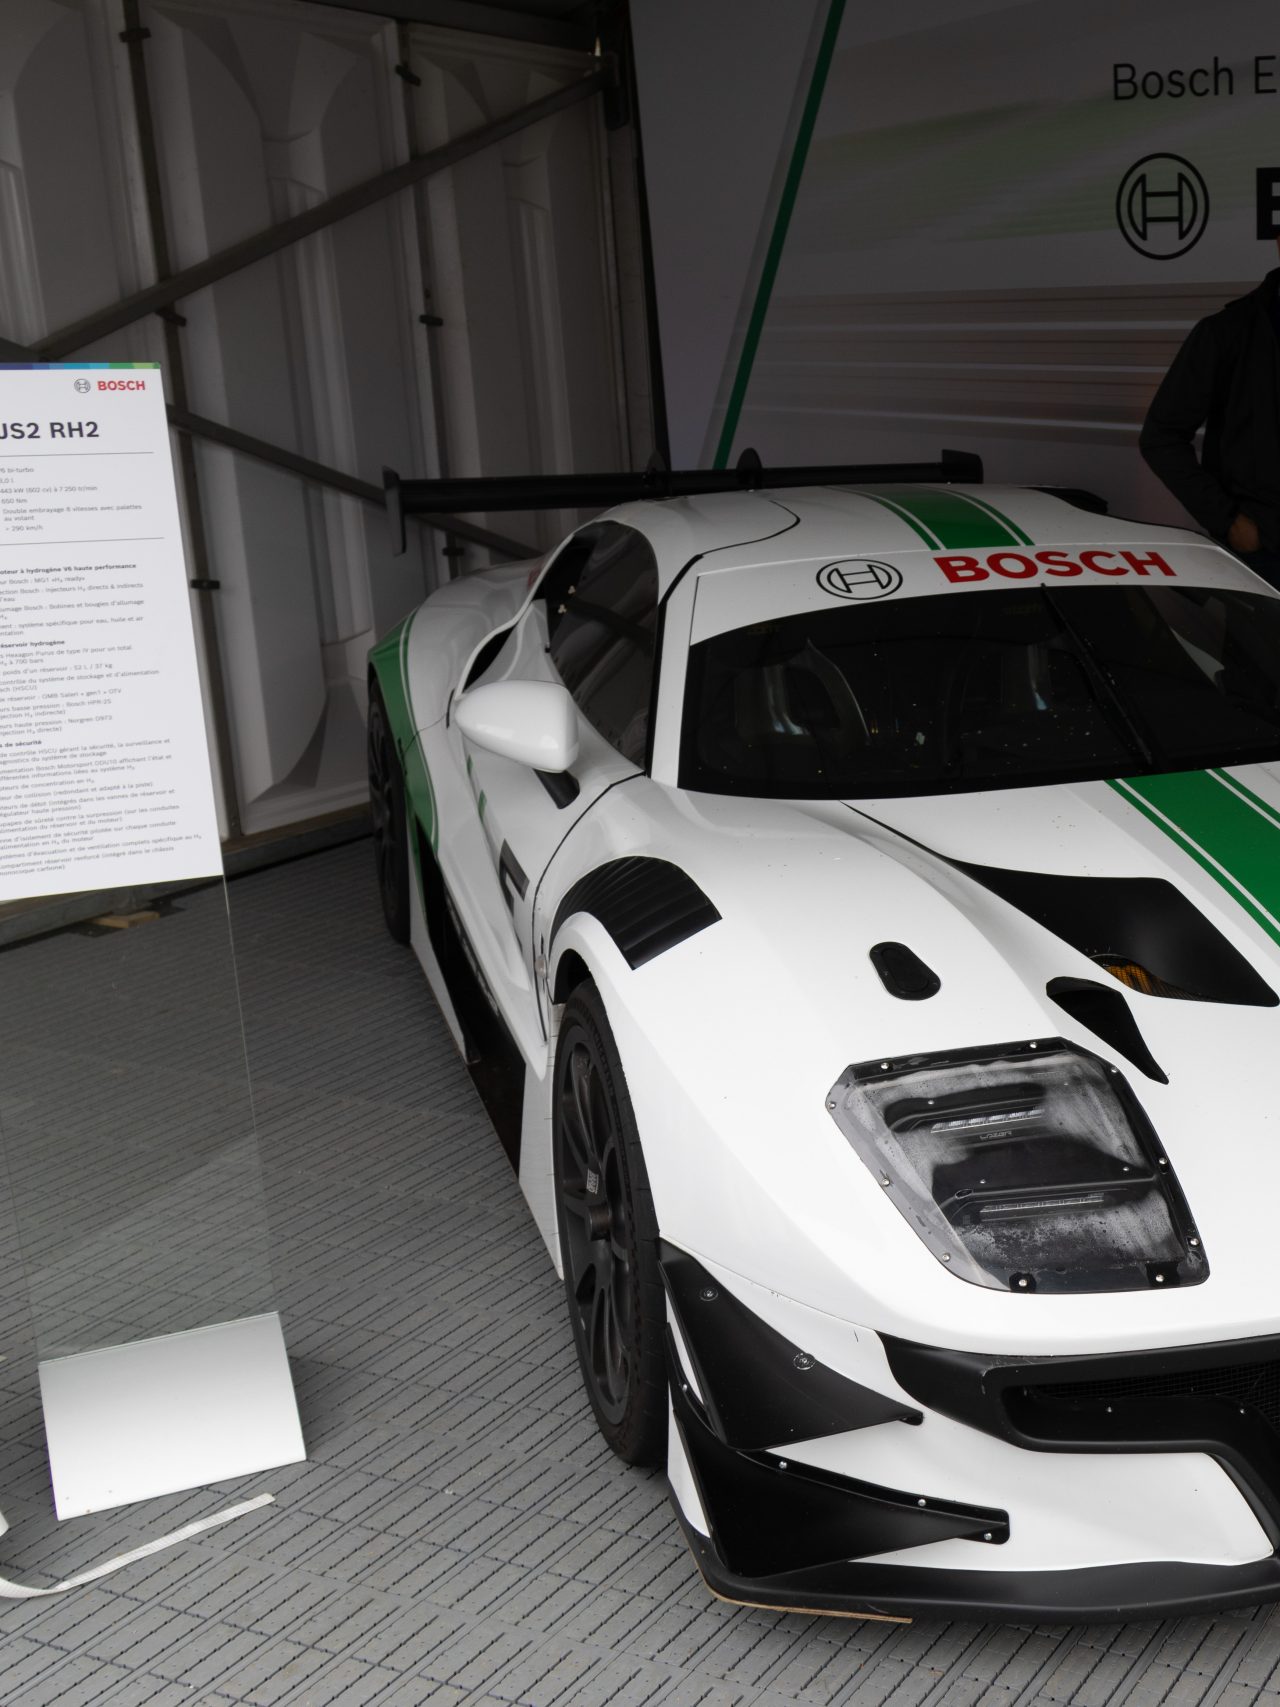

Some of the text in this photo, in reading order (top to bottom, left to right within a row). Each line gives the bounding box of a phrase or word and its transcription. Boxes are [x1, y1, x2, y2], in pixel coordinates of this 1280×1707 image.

[1112, 56, 1234, 101] Bosch
[97, 380, 146, 391] BOSCH
[49, 421, 100, 438] RH2
[932, 550, 1177, 584] BOSCH
